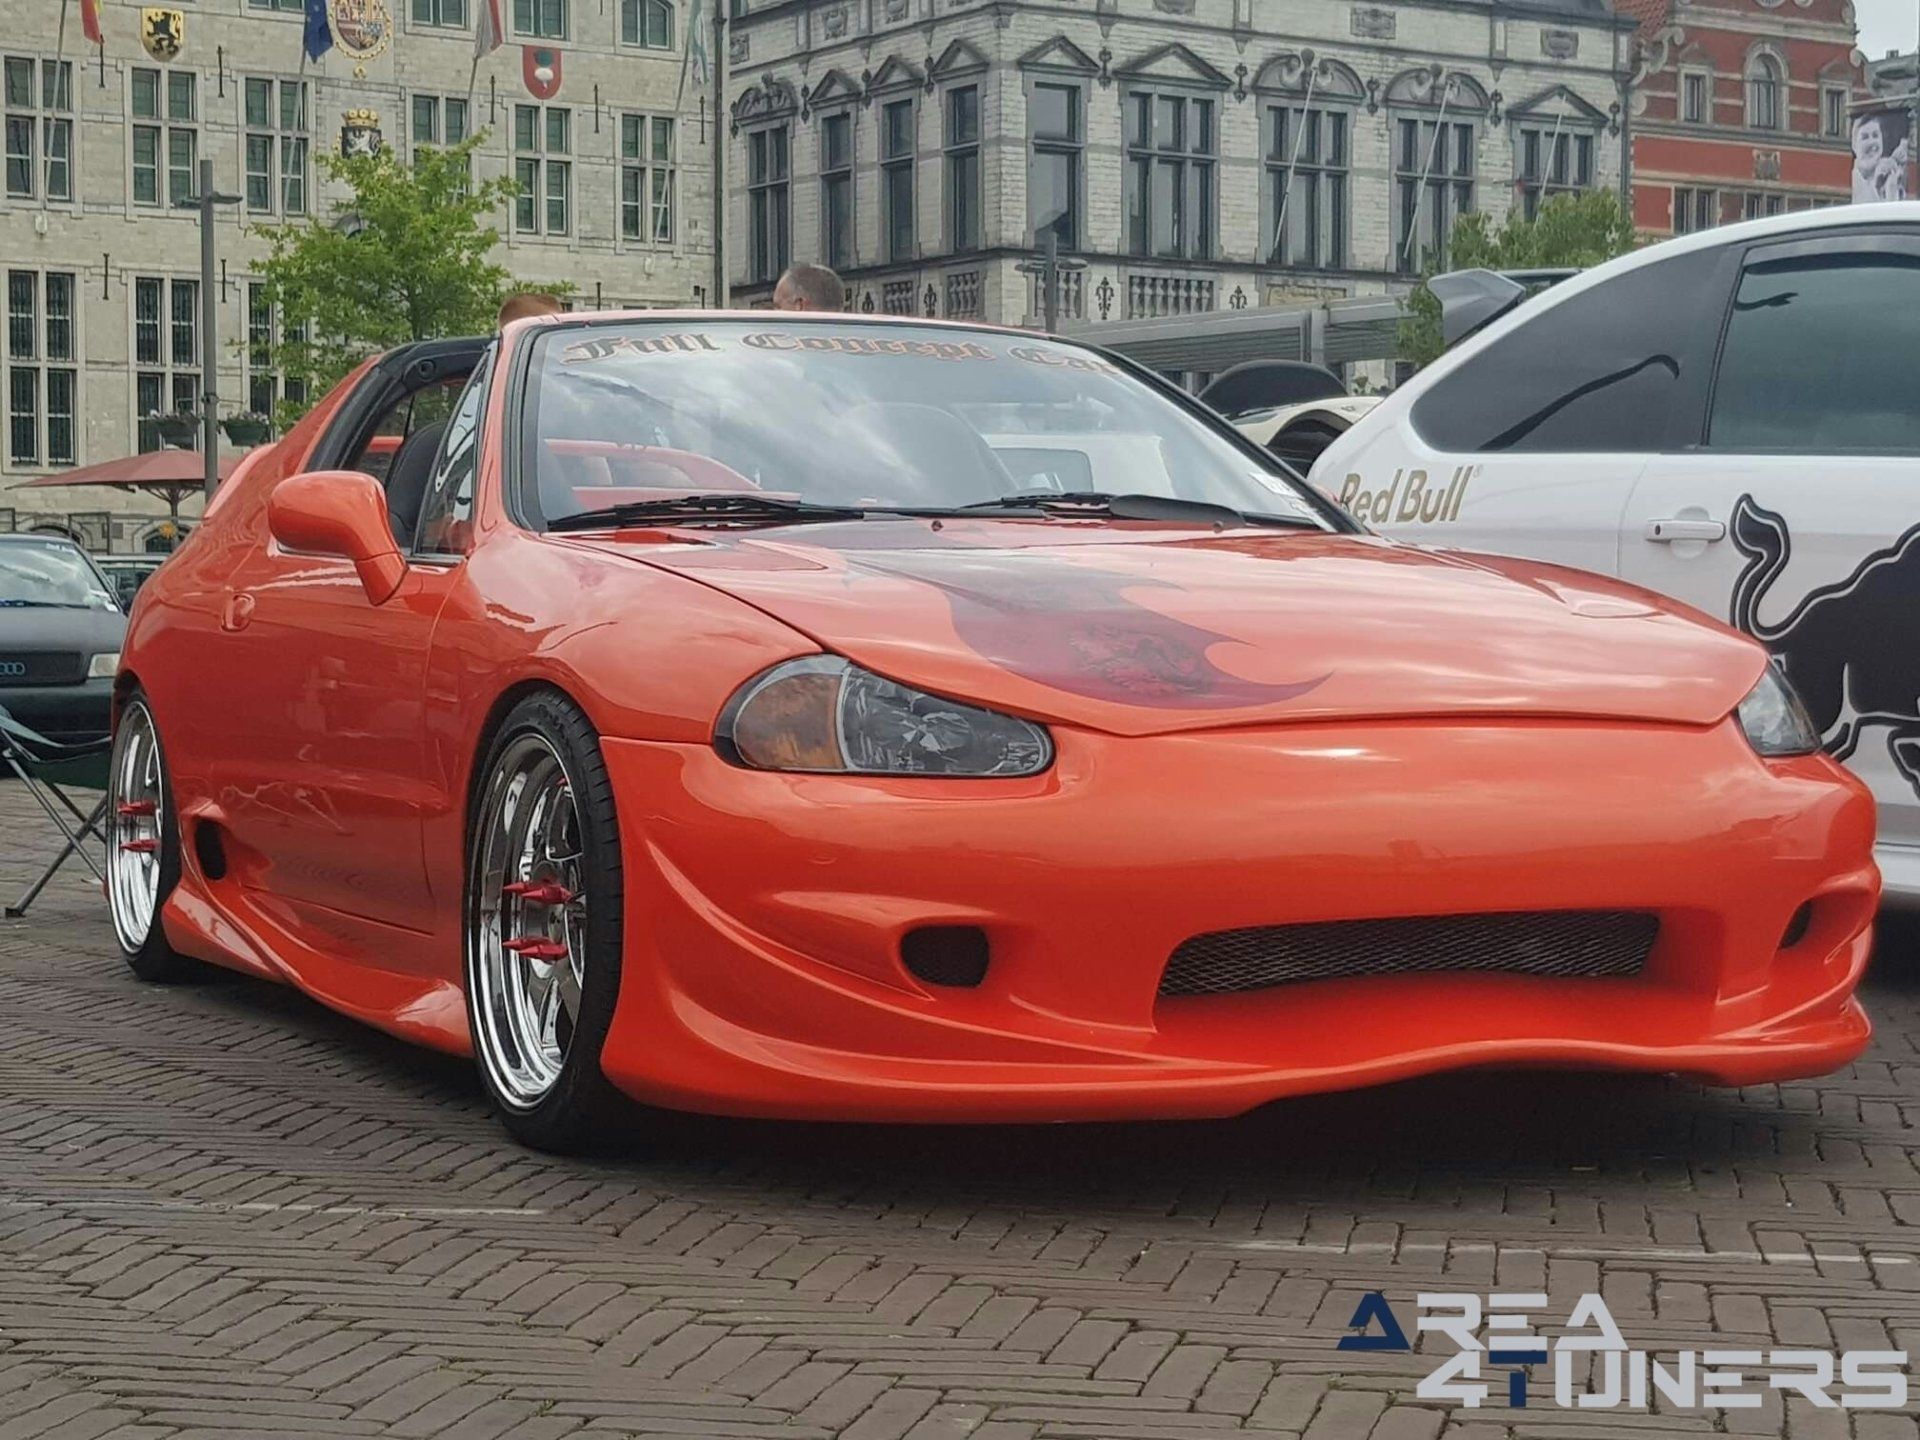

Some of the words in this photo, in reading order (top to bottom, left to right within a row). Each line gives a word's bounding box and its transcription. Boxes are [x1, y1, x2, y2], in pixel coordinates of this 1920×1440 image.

[561, 332, 724, 365] Full
[741, 332, 997, 362] Concept
[1340, 468, 1403, 524] Red
